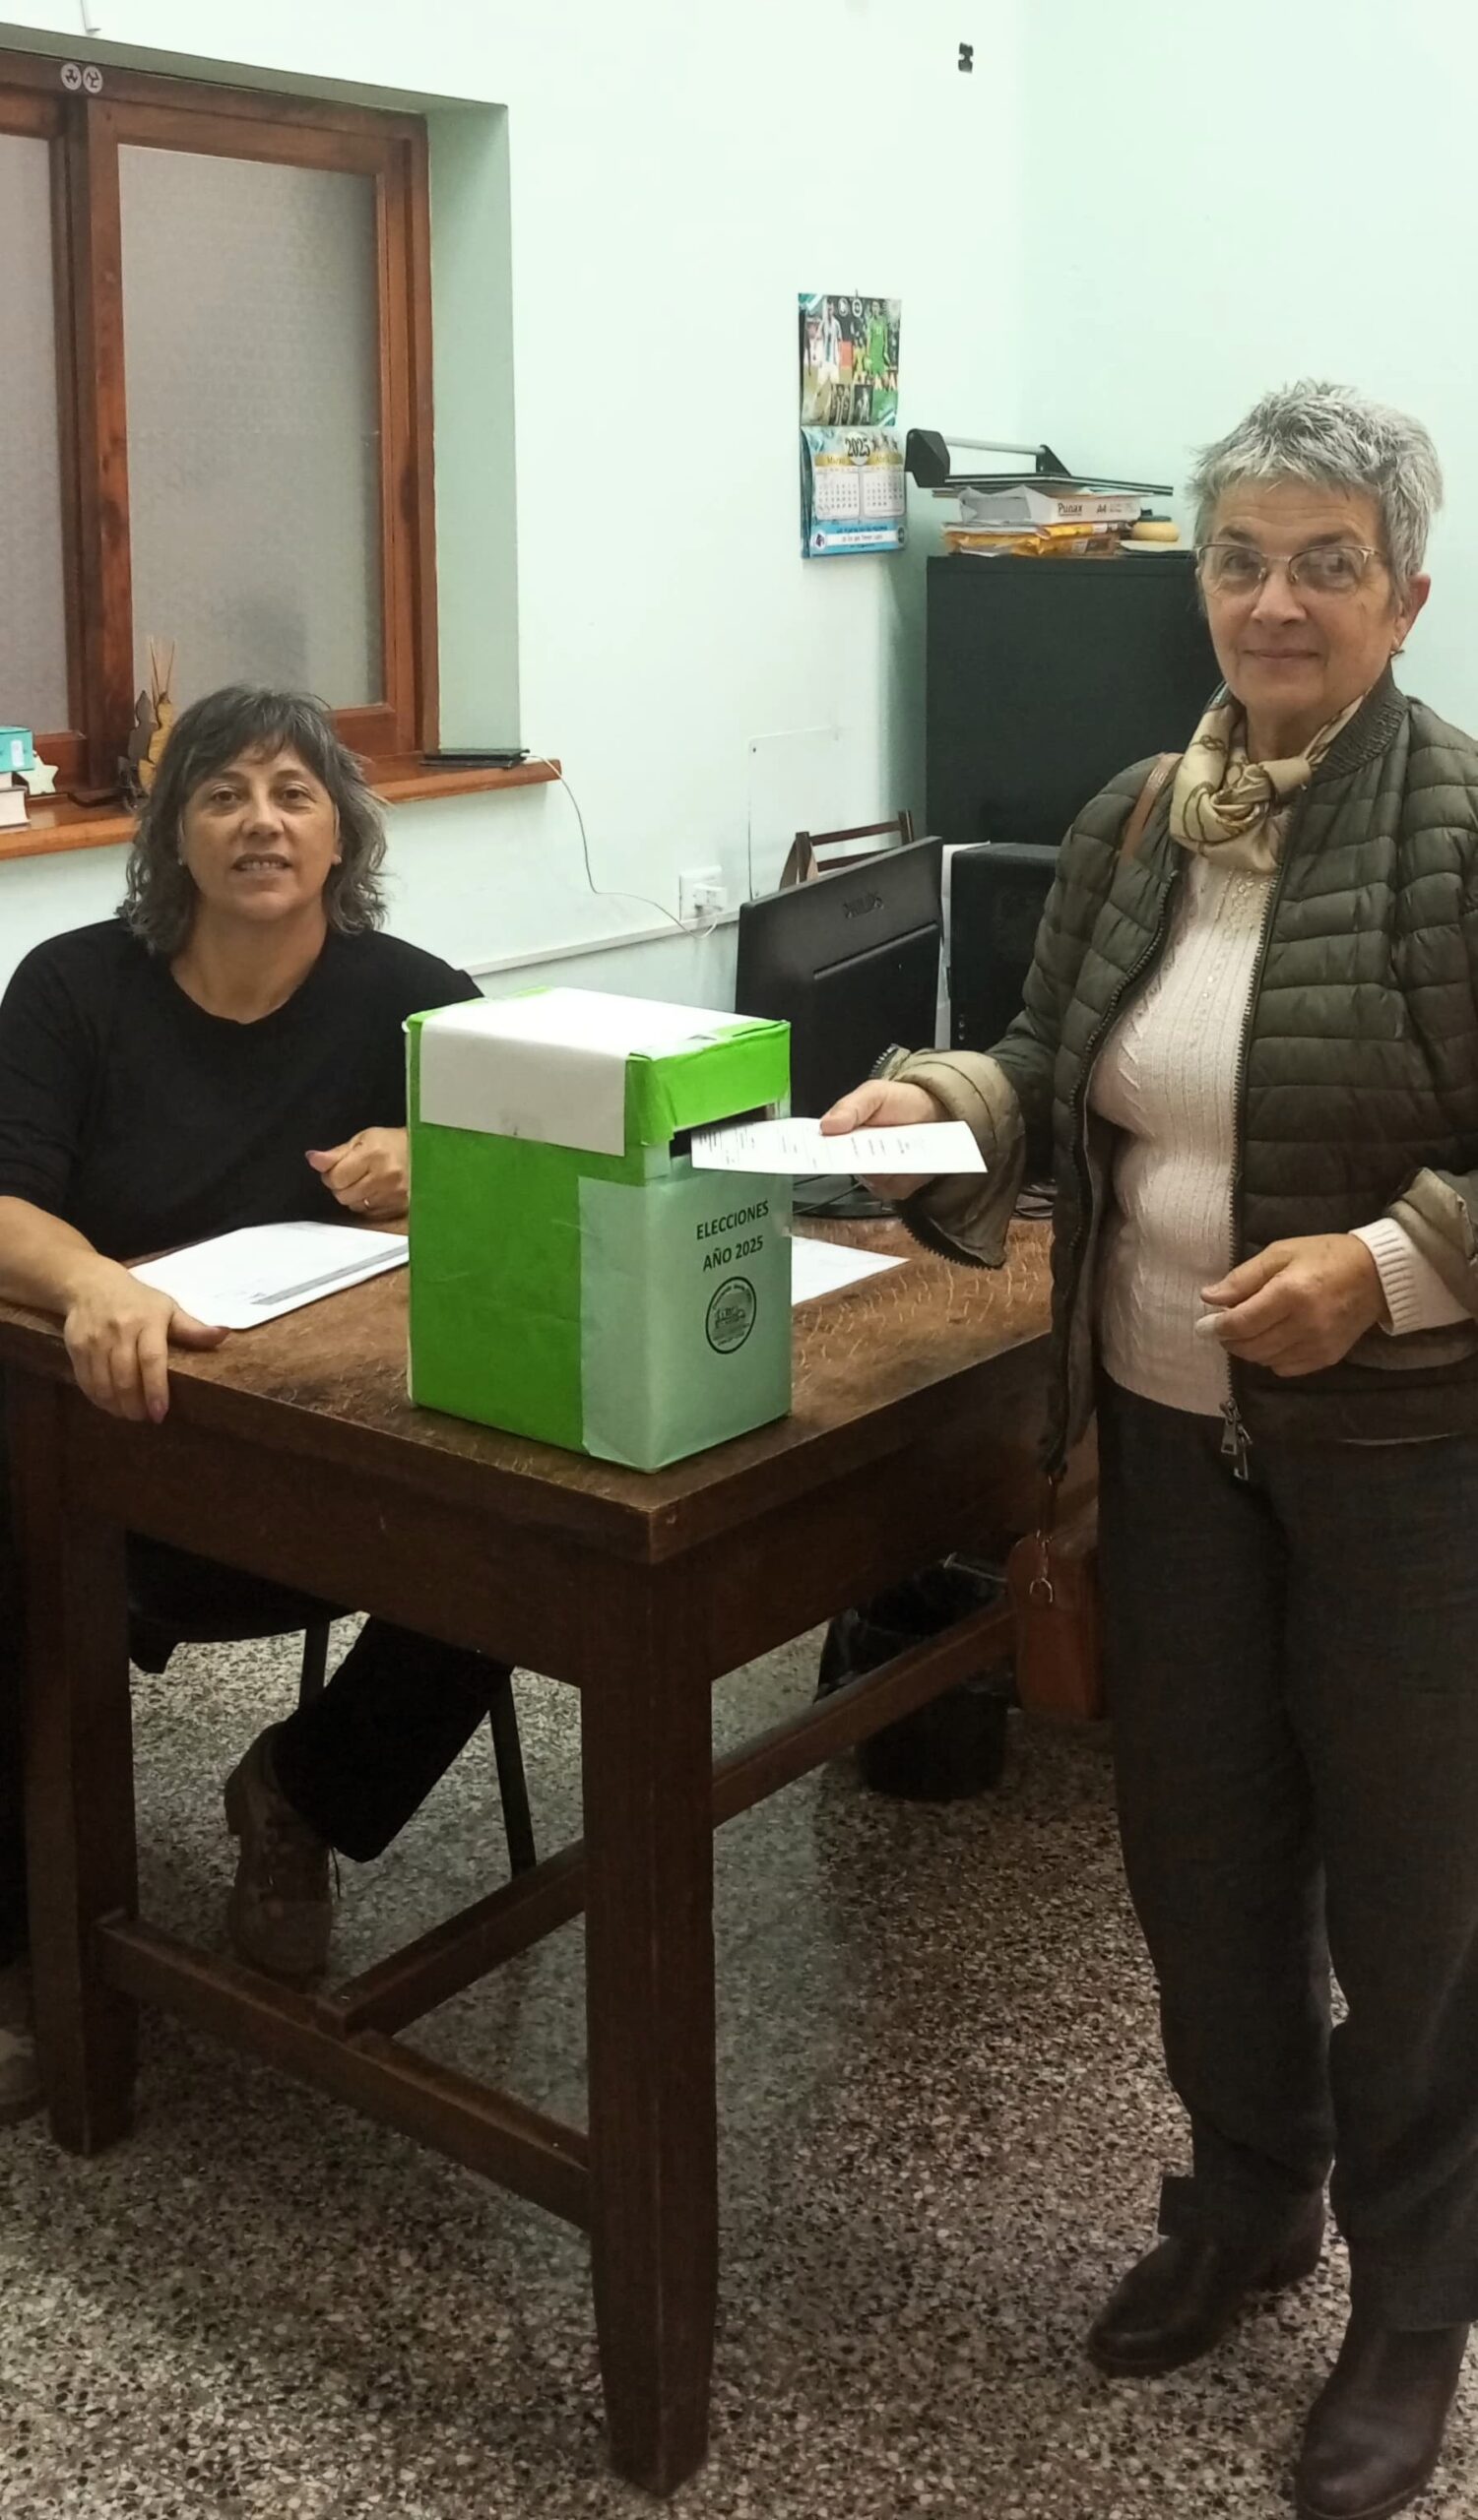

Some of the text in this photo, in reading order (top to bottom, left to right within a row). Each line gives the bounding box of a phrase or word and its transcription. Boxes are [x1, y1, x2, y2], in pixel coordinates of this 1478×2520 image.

[845, 437, 870, 458] 2025
[696, 1200, 769, 1240] ELECCIONES
[703, 1234, 763, 1272] AÑO 2025
